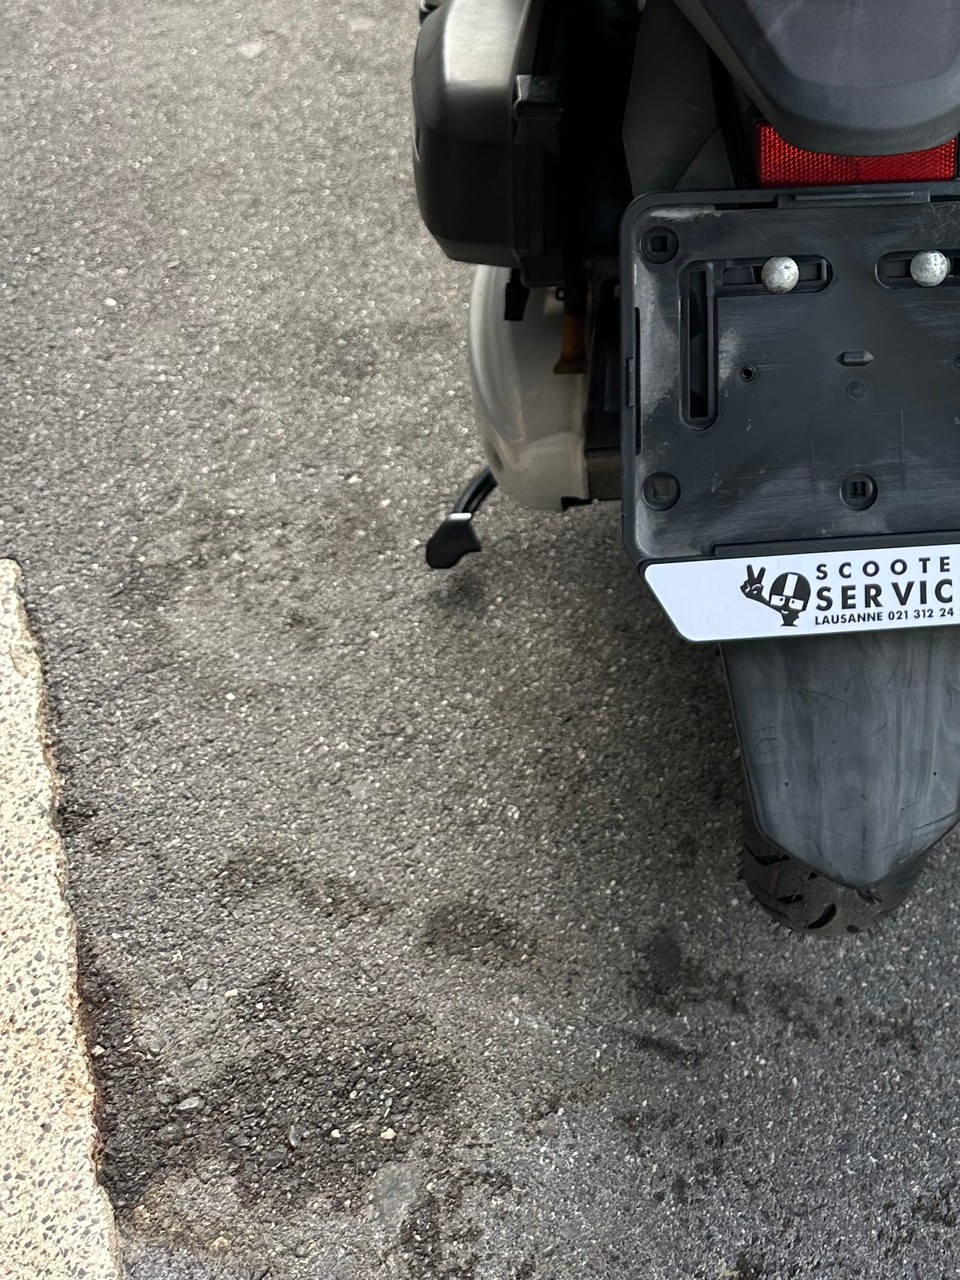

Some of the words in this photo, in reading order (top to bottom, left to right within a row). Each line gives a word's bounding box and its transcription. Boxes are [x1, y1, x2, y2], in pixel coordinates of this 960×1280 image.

[815, 612, 883, 625] LAUSANNE
[888, 610, 908, 620] 021
[914, 609, 934, 619] 312
[939, 607, 954, 617] 24
